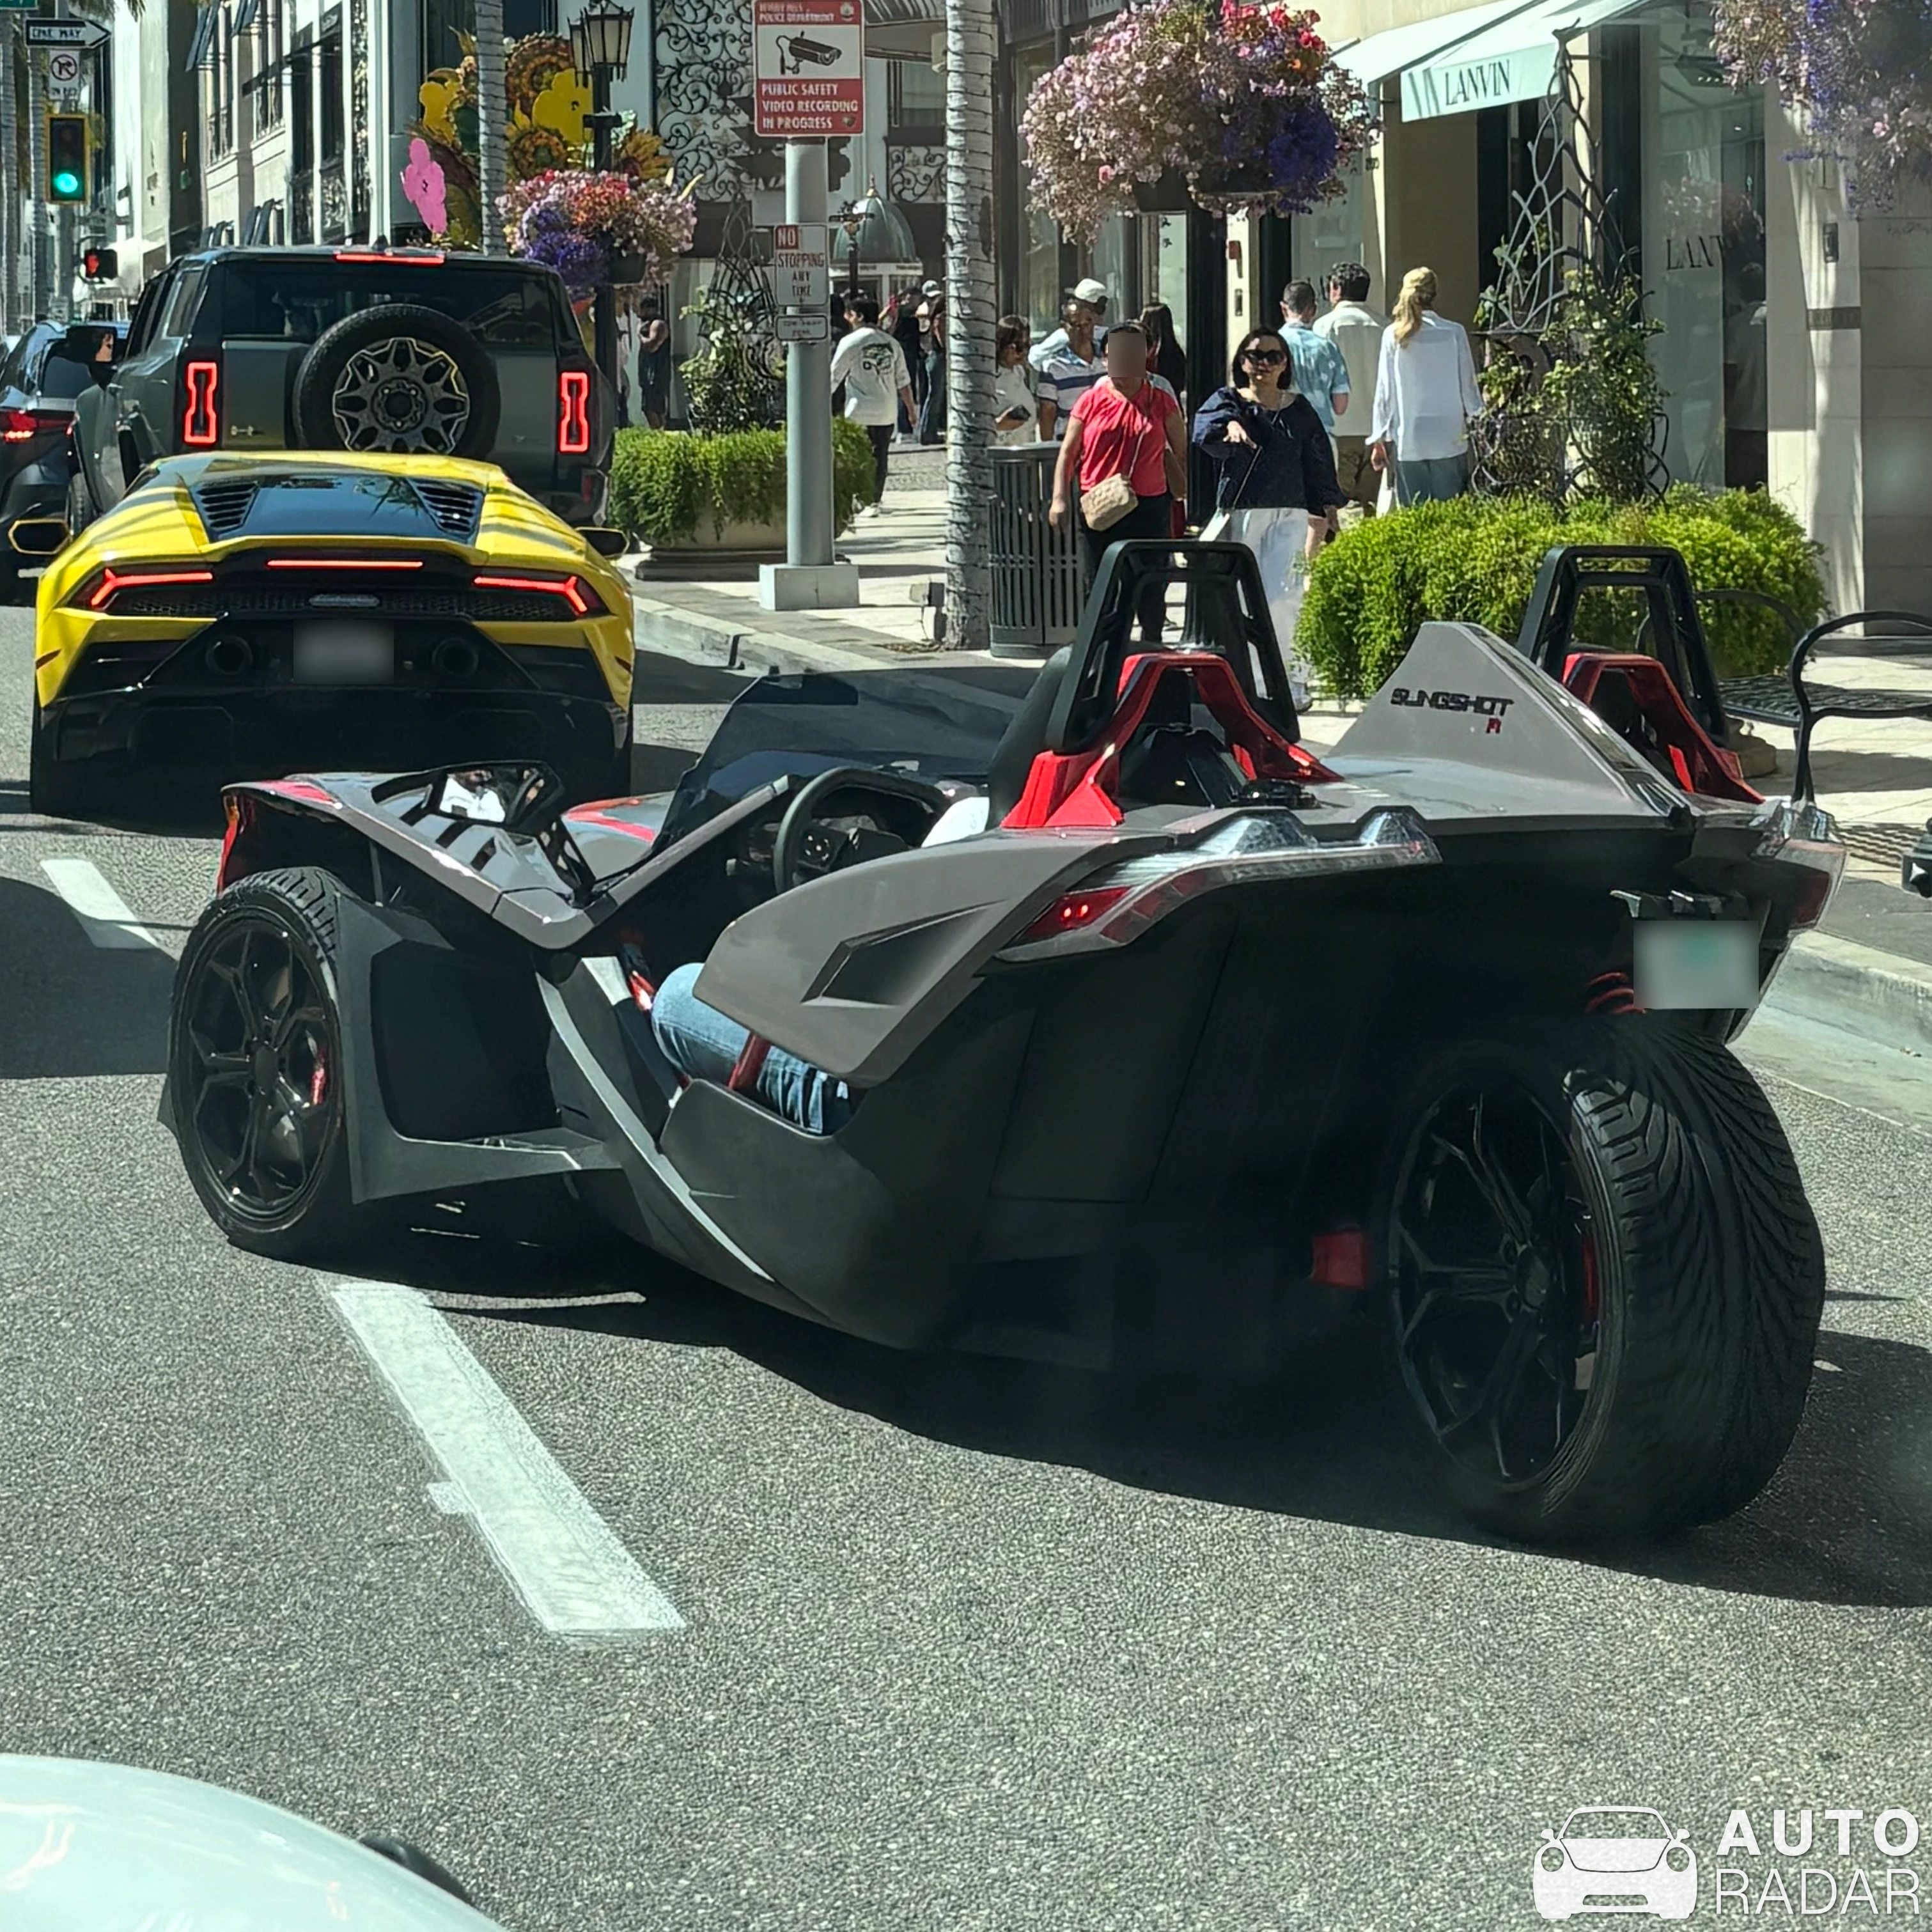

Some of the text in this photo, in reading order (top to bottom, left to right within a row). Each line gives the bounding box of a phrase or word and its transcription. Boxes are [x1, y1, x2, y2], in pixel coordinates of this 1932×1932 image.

[59, 28, 81, 38] WAY
[1445, 59, 1510, 105] LANVIN
[761, 84, 838, 96] PUBLIC SAFETY
[762, 100, 859, 113] VIDEO RECORDING
[763, 116, 832, 129] IN PROGRESS
[777, 228, 796, 246] NO
[778, 253, 824, 267] STOPPING
[793, 271, 810, 281] ANY
[792, 286, 811, 296] TIME
[1391, 688, 1514, 716] SLINGSHOT
